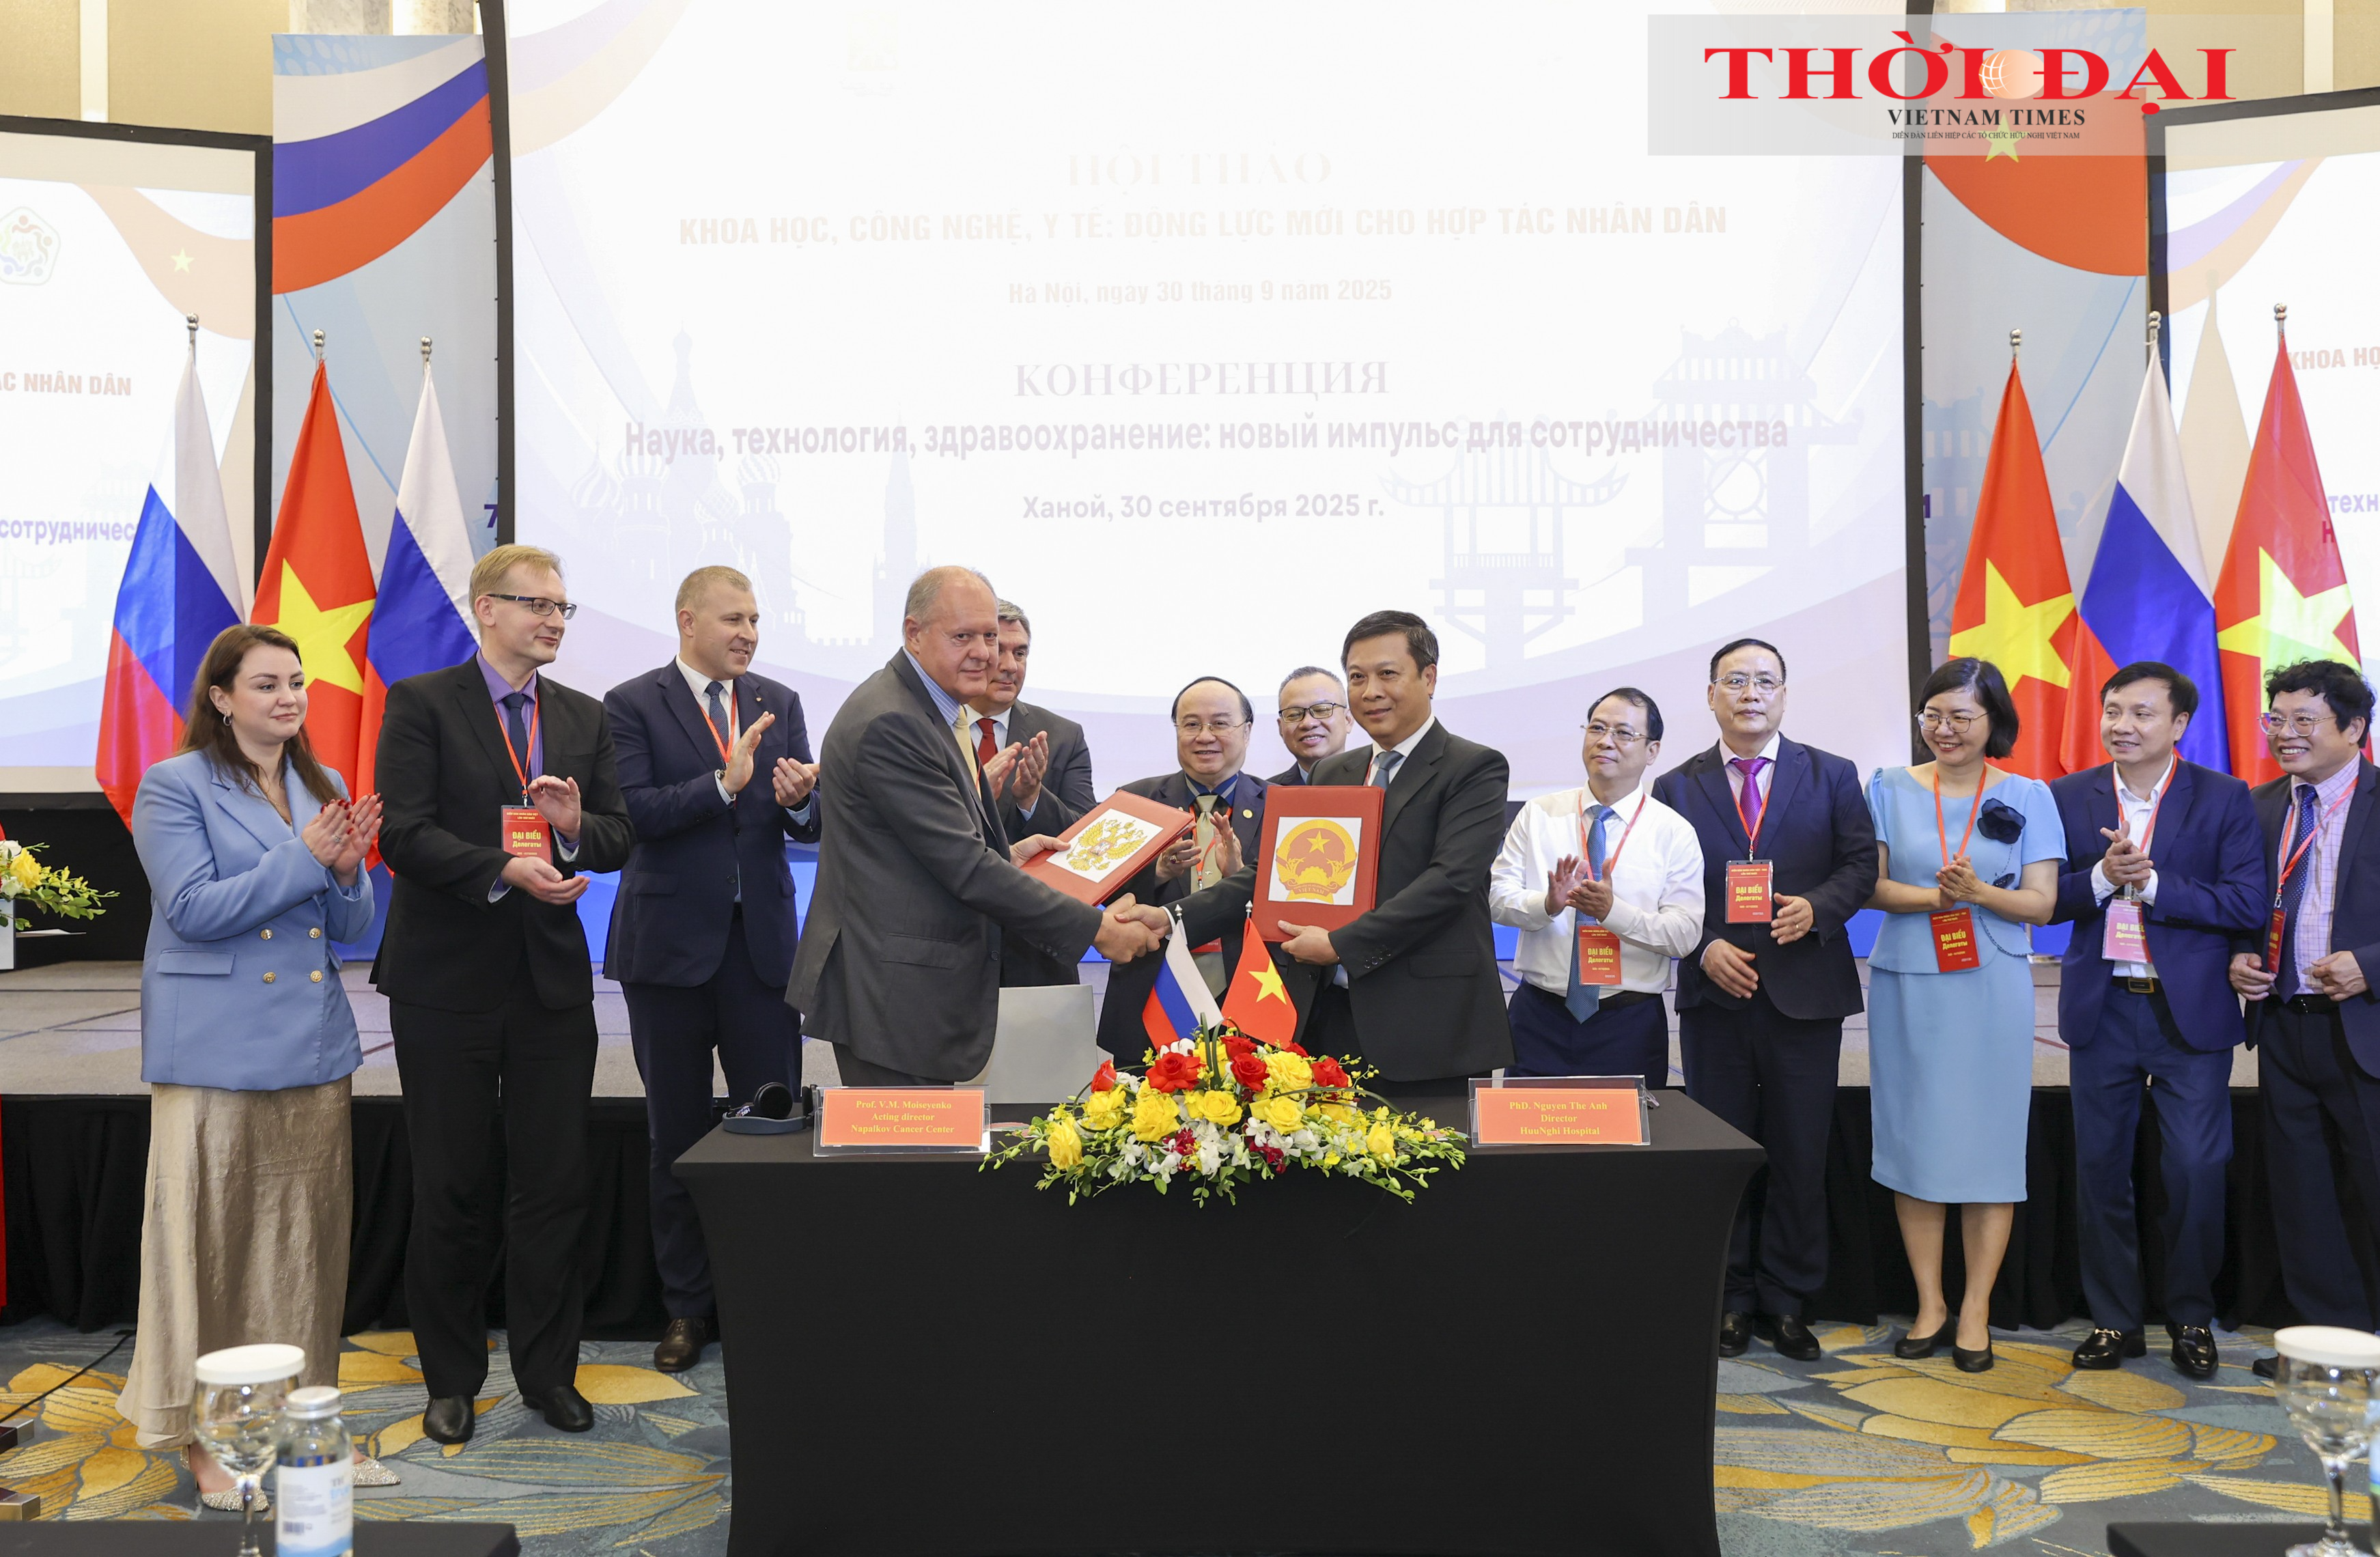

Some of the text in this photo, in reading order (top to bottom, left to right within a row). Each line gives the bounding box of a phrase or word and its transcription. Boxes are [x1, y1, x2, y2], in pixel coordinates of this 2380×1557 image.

[680, 218, 759, 245] KHOA
[771, 216, 838, 249] HỌC,
[850, 208, 930, 242] CÔNG
[1043, 213, 1059, 239] Y
[1124, 206, 1206, 244] ĐỘNG
[1218, 208, 1274, 242] LỰC
[1287, 204, 1343, 236] MỚI
[1356, 209, 1415, 236] CHO
[1427, 206, 1487, 241] HỢP
[1498, 202, 1555, 235] TÁC
[1567, 201, 1652, 234] NHÂN
[1664, 199, 1726, 234] DÂN
[1009, 282, 1037, 304] Hà
[1157, 281, 1183, 302] 30
[1191, 280, 1253, 304] tháng
[1261, 279, 1274, 300] 9
[1281, 280, 1329, 301] năm
[1337, 279, 1392, 300] 2025
[24, 370, 82, 394] NHÂN
[89, 372, 132, 396] DÂN
[1013, 361, 1390, 402] КОНФЕРЕНЦИЯ
[625, 411, 1788, 464] Наука, технология, здравоохранение: новый импульс для сотрудничества
[1024, 492, 1384, 523] Ханой, 30 сентября 2025 г.
[856, 1100, 952, 1110] Prof. V.M. Moiseyenko
[871, 1113, 899, 1122] Acting
[1509, 1102, 1531, 1110] PhD.
[1534, 1102, 1567, 1112] Nguyen
[1569, 1102, 1586, 1110] The
[893, 1125, 923, 1134] Cancer
[925, 1125, 955, 1134] Center
[1520, 1127, 1600, 1137] HuuNghi Hospital
